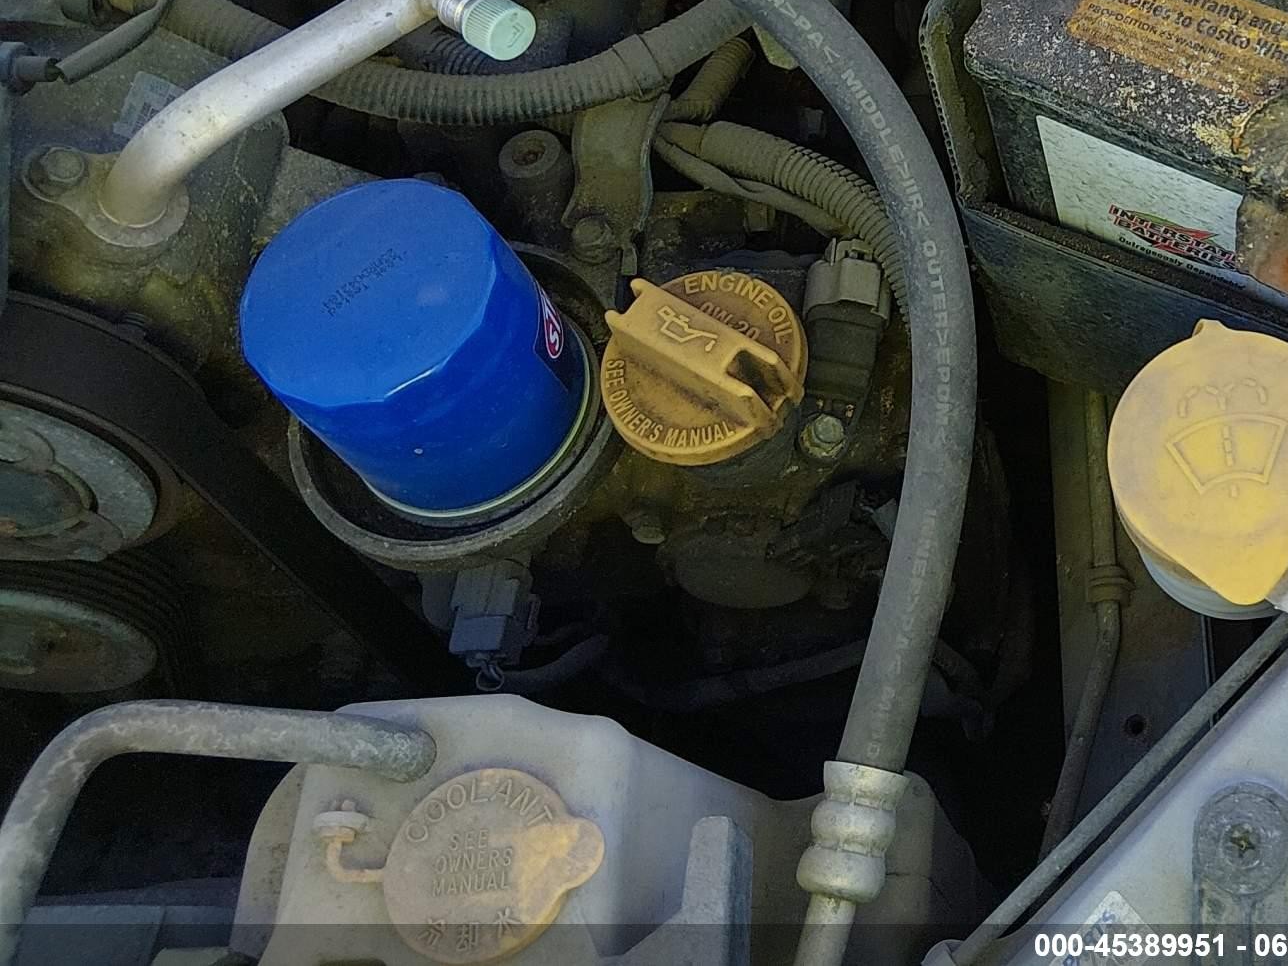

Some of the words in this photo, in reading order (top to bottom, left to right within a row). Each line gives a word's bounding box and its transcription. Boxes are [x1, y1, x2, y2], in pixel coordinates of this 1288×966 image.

[1173, 7, 1193, 28] to
[1196, 17, 1252, 50] Costco
[1248, 11, 1288, 36] and
[1118, 236, 1184, 267] Outrageously
[684, 275, 773, 308] ENGINE
[767, 306, 793, 344] OIL
[606, 359, 624, 386] SEE
[609, 390, 663, 442] OWNER'S
[664, 421, 735, 448] MANUAL
[405, 778, 554, 842] COOLANT
[449, 829, 489, 850] SEE
[435, 848, 513, 875] OWNERS
[432, 872, 511, 898] MANUAL
